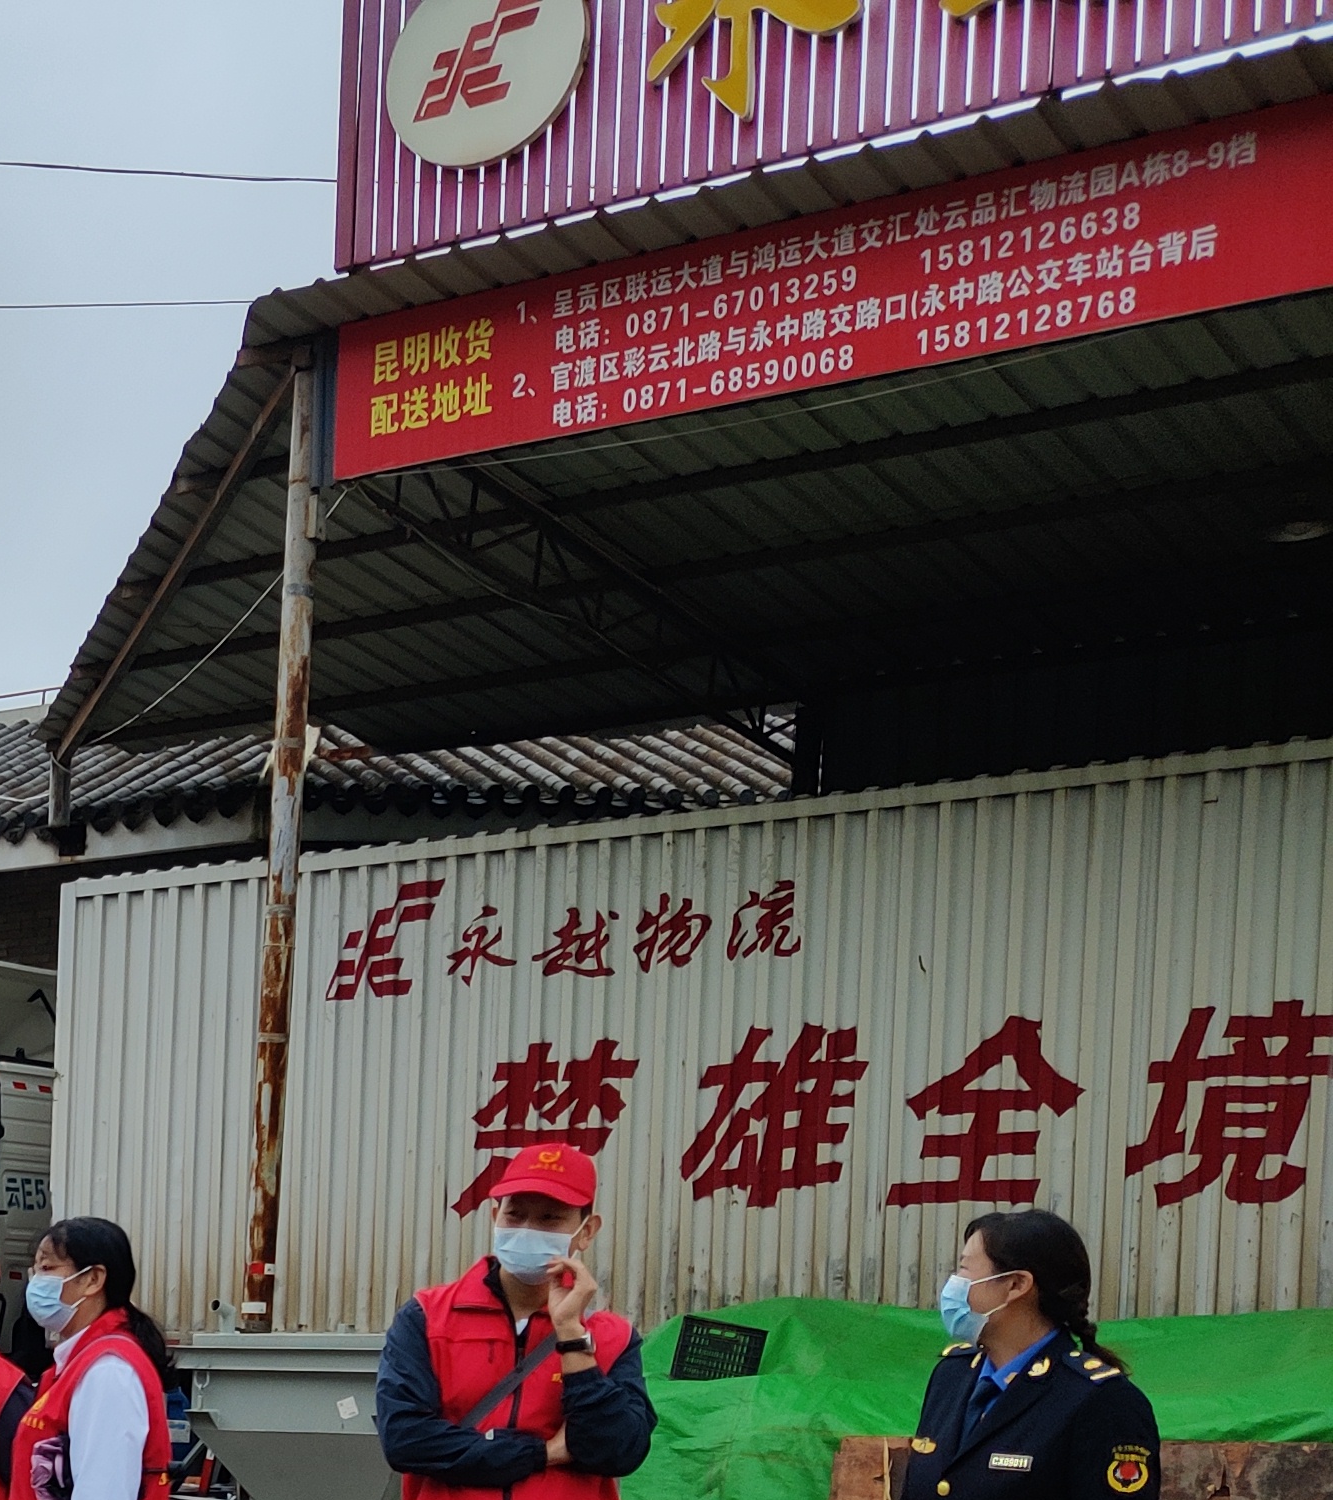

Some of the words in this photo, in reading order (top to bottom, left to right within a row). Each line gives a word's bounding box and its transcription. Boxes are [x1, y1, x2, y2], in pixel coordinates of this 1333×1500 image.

[920, 202, 1141, 274] 15812126638
[373, 318, 495, 386] 昆明收货
[916, 287, 1136, 355] 15812128768
[370, 372, 493, 438] 配送地址
[446, 879, 803, 986] 永越物流
[452, 999, 1333, 1218] 楚雄全境
